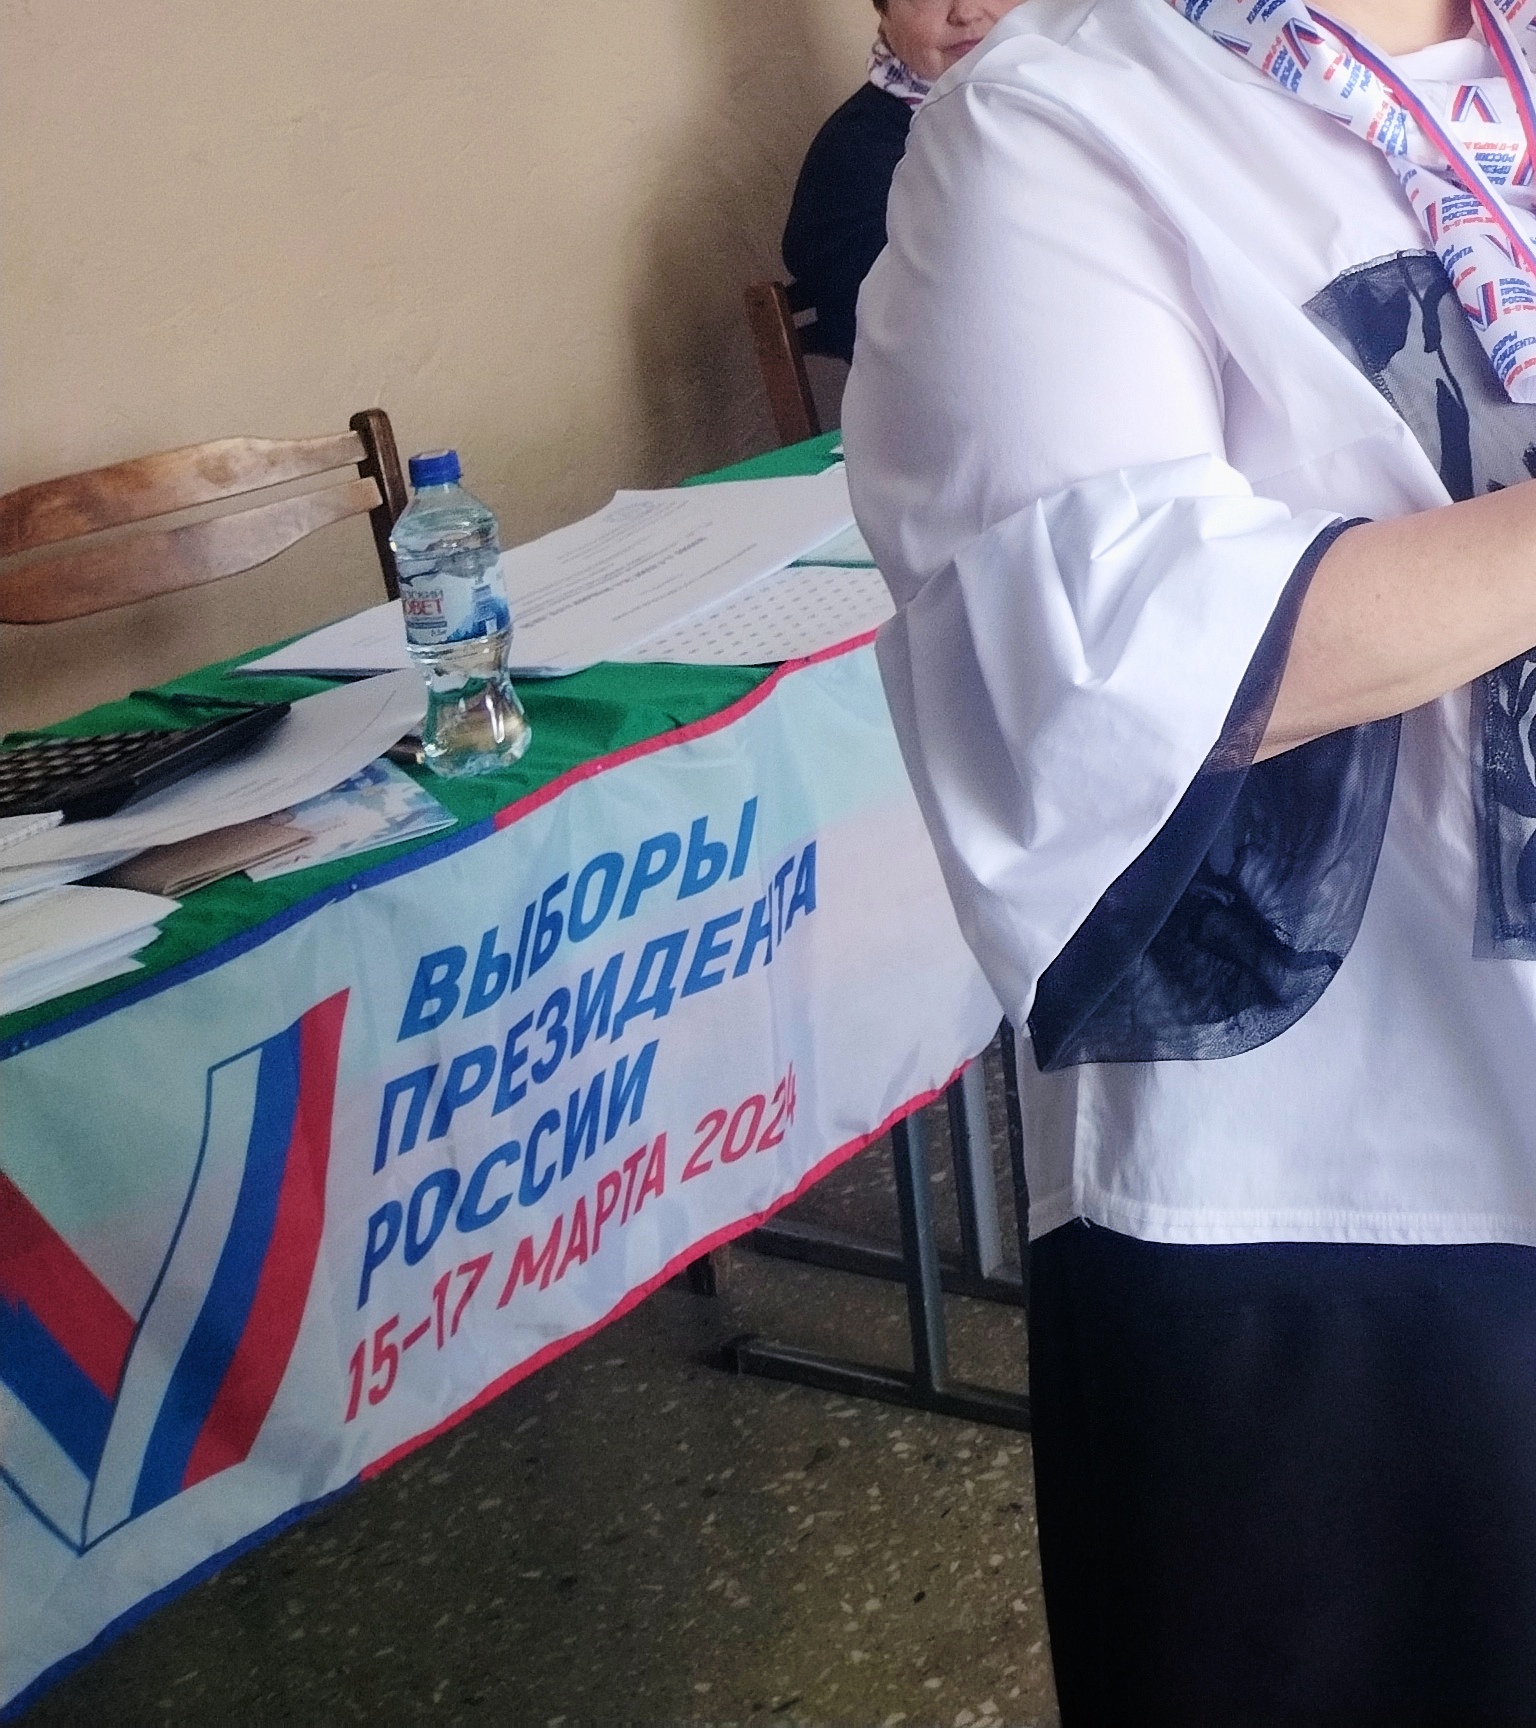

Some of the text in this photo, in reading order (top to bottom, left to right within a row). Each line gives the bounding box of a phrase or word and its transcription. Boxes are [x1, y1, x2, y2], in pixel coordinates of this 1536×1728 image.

[1474, 152, 1515, 162] РОССИИ
[372, 840, 817, 1176] ПРЕЗИДЕНТА
[397, 795, 759, 1043] ВЫБОРЫ
[357, 1039, 660, 1311] РОССИИ
[497, 1133, 669, 1310] МАРТА
